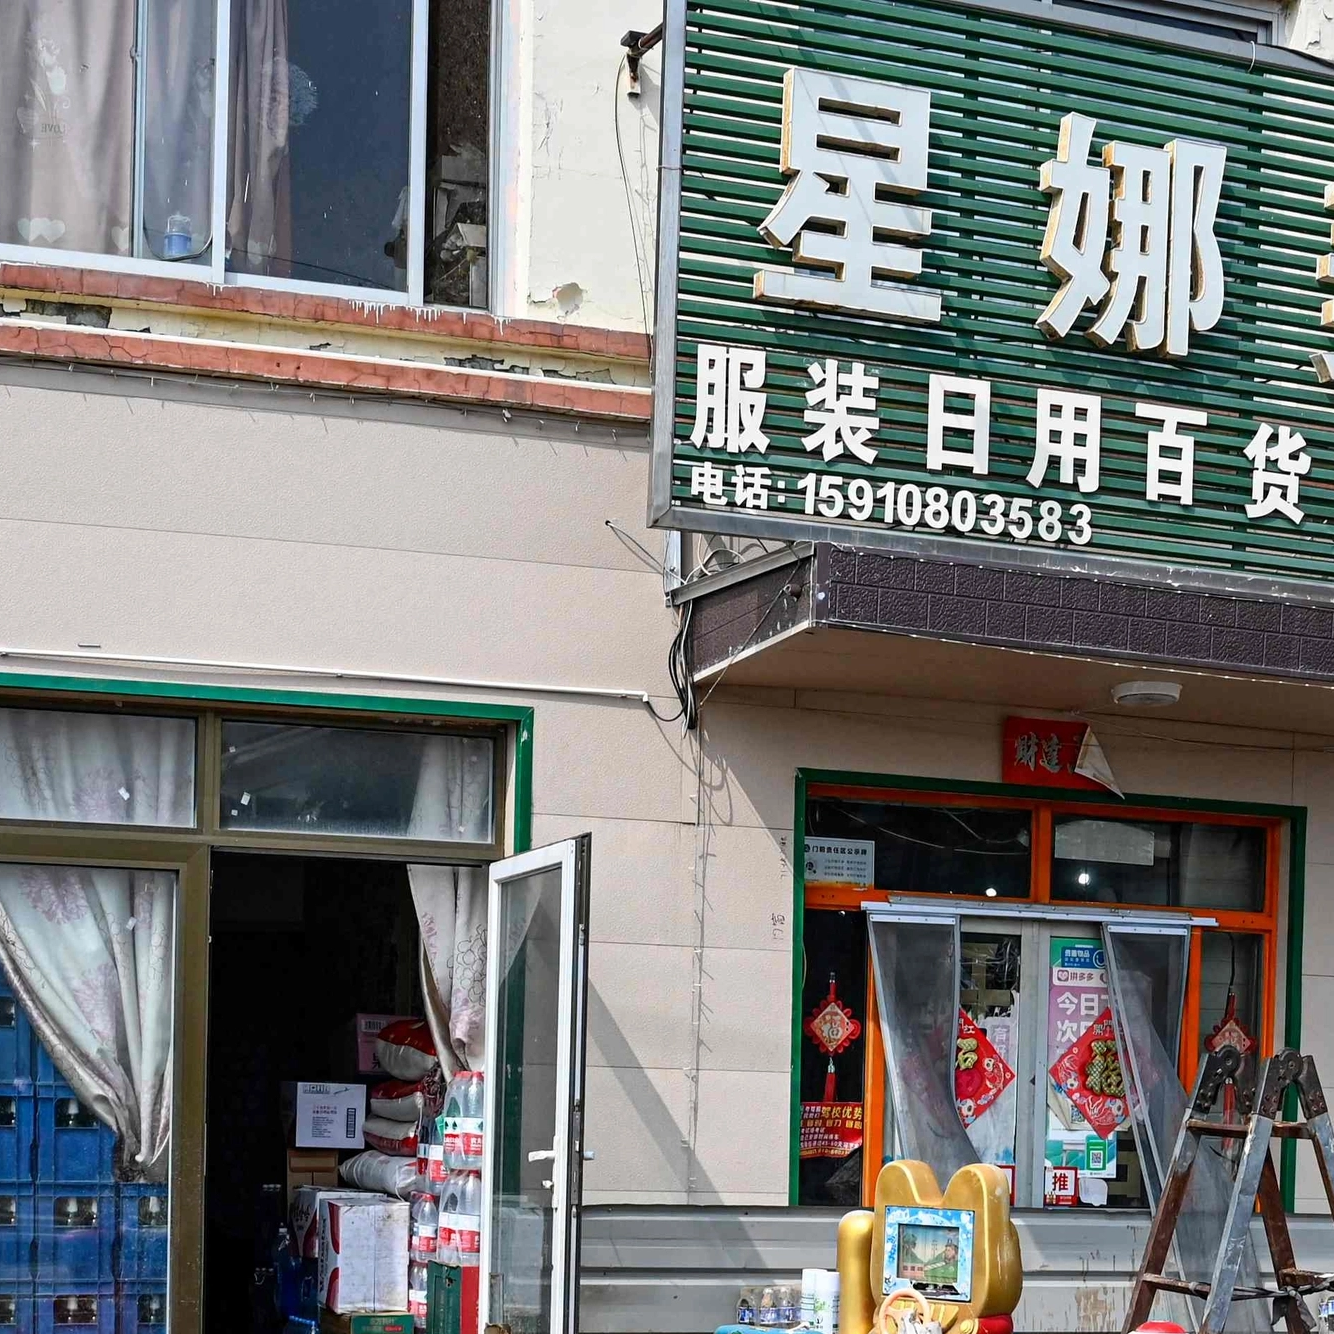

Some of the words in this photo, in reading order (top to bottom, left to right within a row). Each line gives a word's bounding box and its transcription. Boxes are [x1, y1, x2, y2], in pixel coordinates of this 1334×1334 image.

[1070, 972, 1094, 981] 拼多多
[1057, 991, 1108, 1016] 今日
[1052, 1172, 1069, 1192] 推
